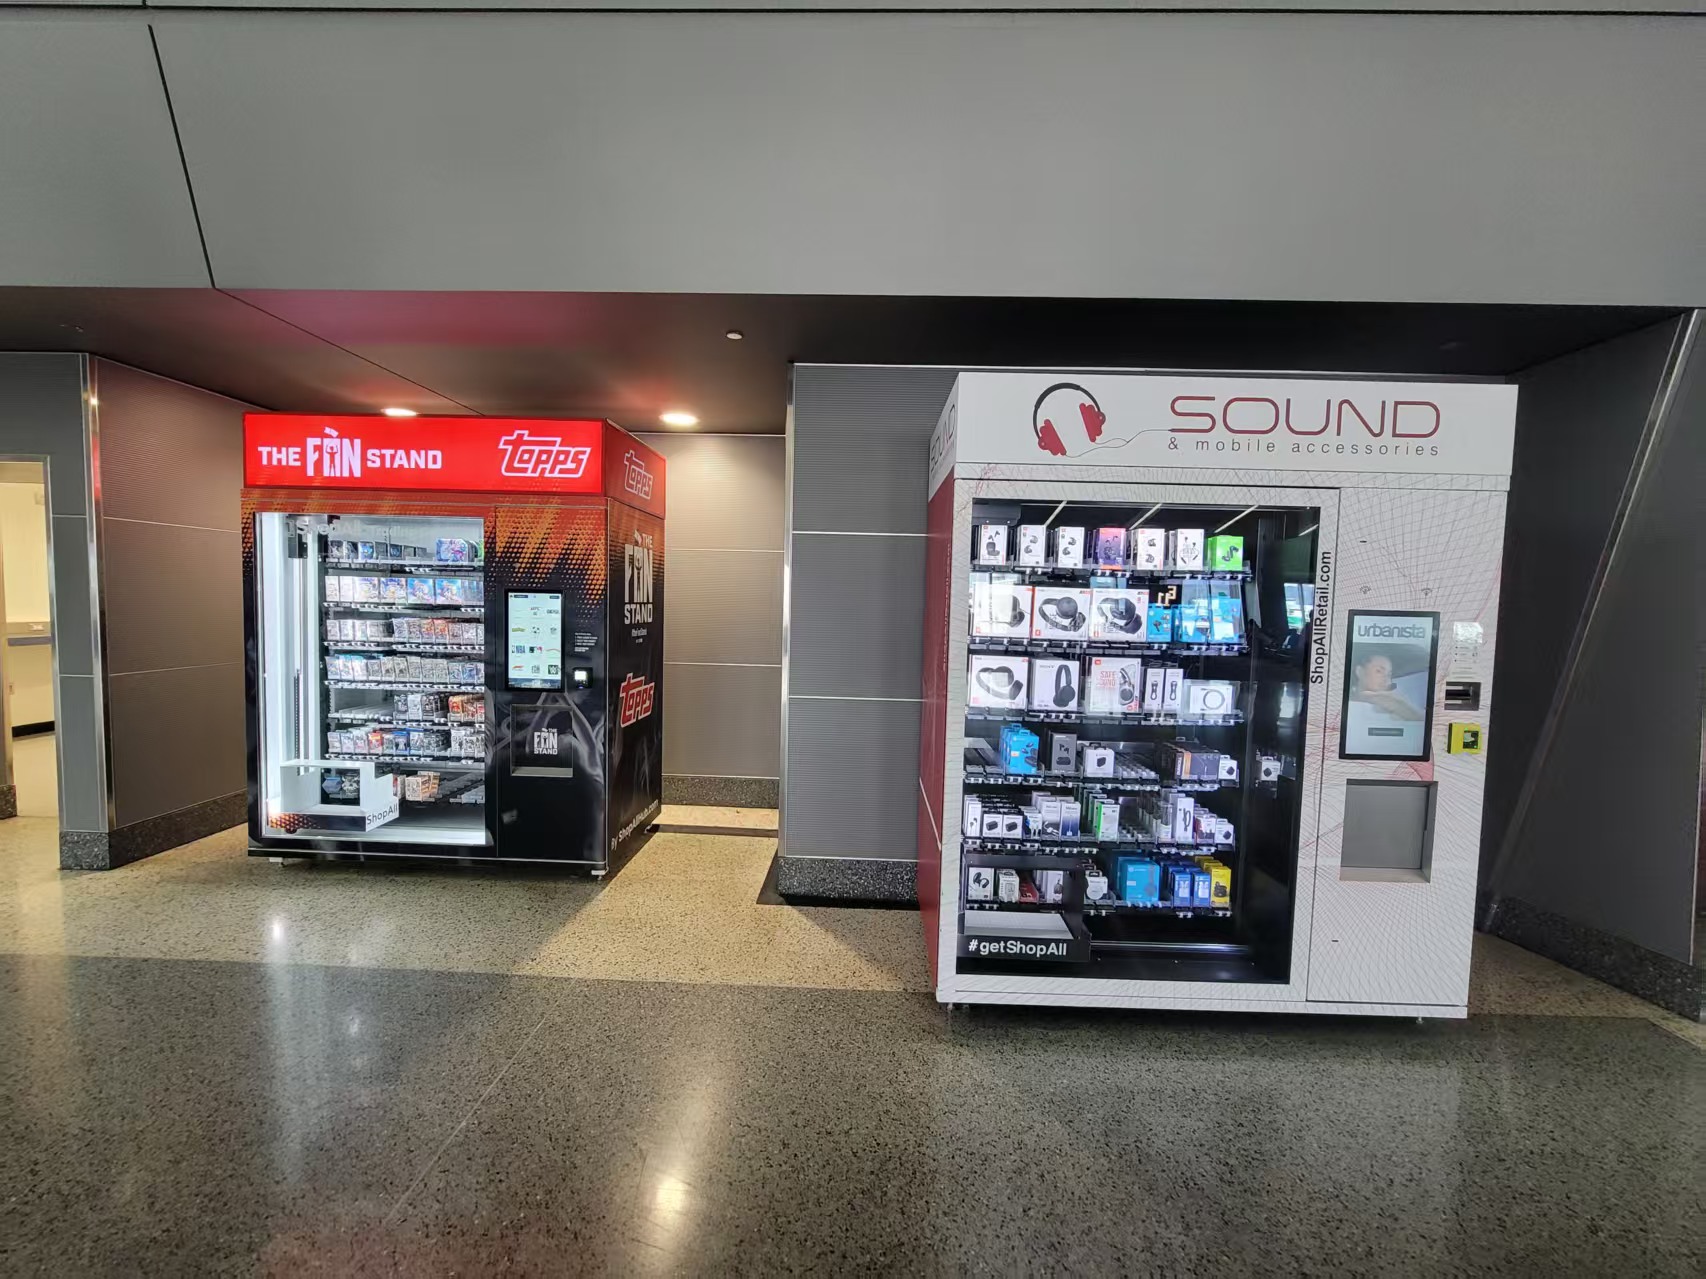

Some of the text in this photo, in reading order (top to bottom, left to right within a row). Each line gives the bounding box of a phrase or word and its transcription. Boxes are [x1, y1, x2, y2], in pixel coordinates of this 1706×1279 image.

[1169, 396, 1441, 438] SOUND
[258, 437, 442, 477] THE FAN STAND
[1168, 437, 1439, 456] & mobile accessories
[624, 603, 653, 625] STAND
[1311, 551, 1331, 684] ShopAllRetail.com
[1358, 623, 1426, 638] urbanista
[534, 747, 558, 755] STAND
[367, 803, 397, 825] ShopAll
[968, 939, 1067, 958] #getShopAll
